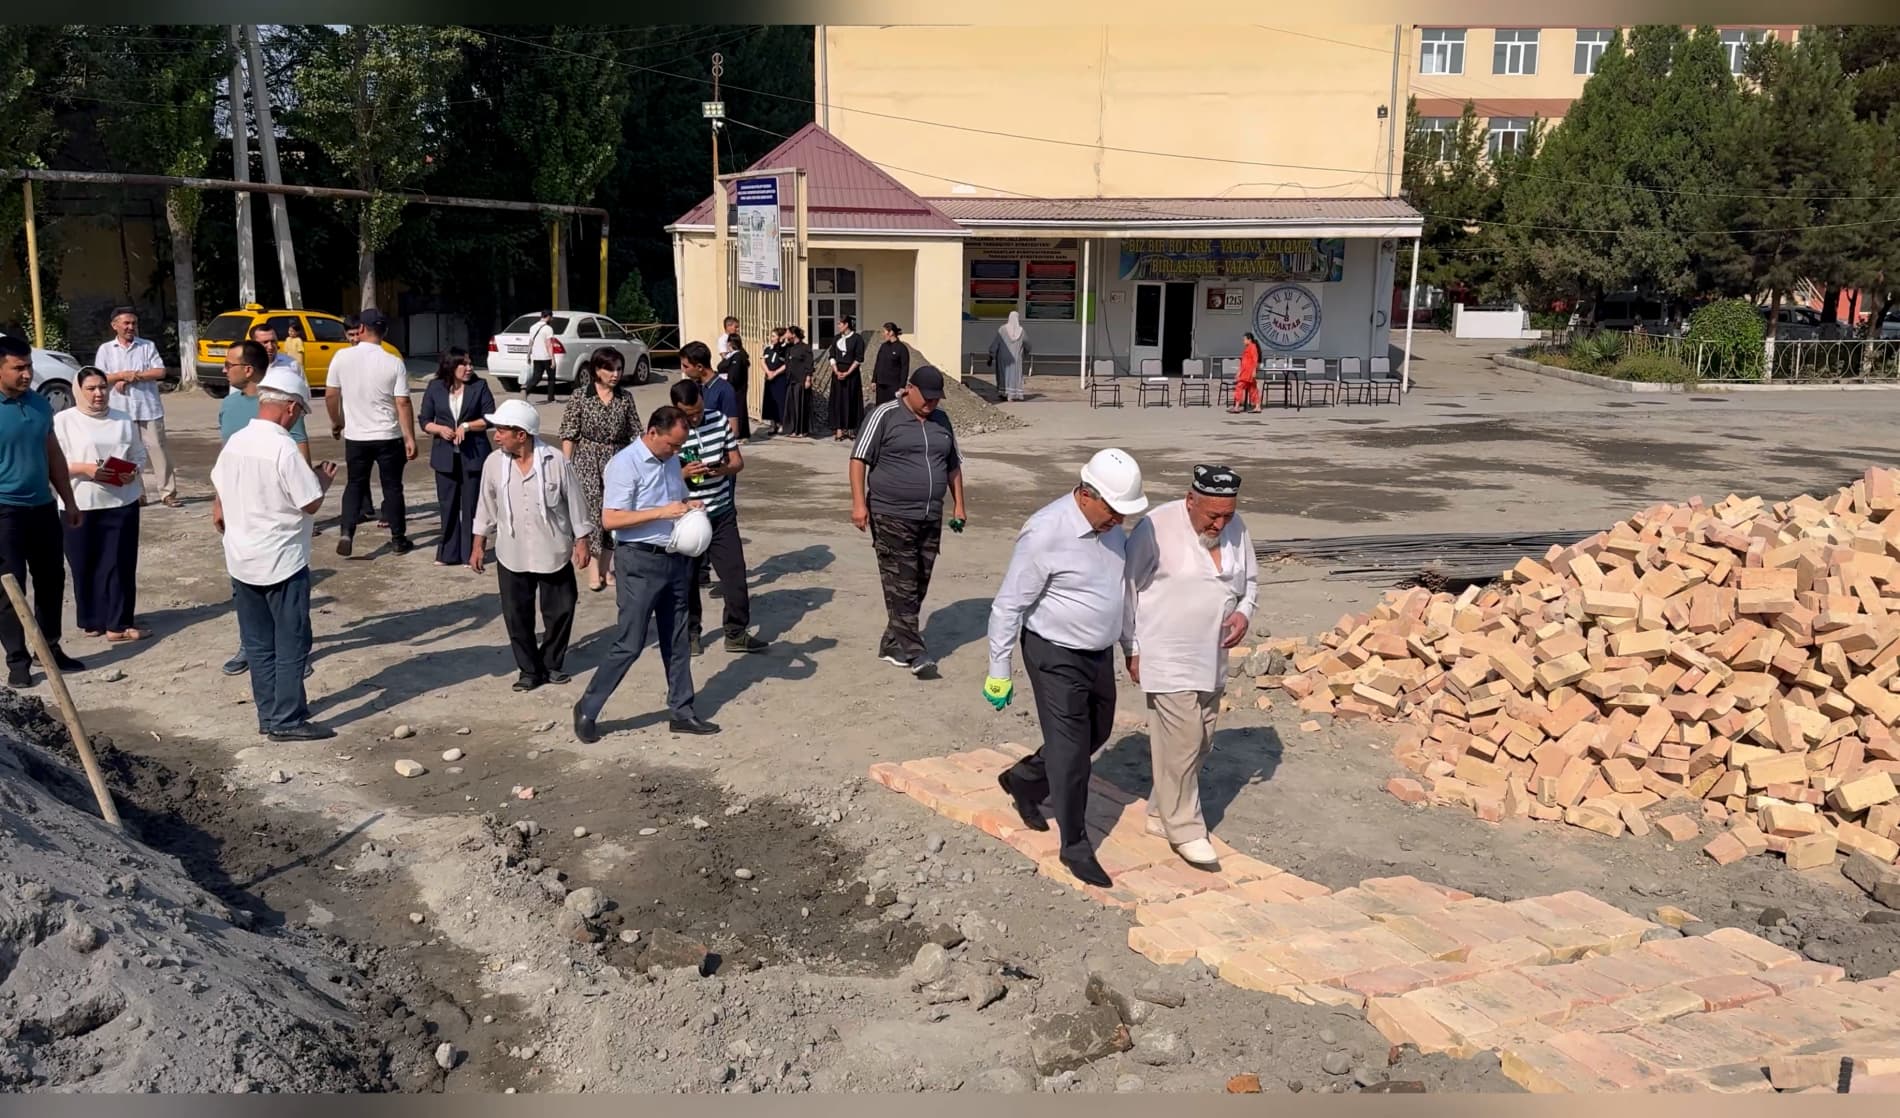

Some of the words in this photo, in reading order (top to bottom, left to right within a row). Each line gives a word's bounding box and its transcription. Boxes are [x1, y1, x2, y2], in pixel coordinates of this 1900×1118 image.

[1128, 239, 1145, 252] BIZ
[1148, 239, 1165, 252] BIR
[1222, 239, 1261, 252] YAGONA
[1152, 259, 1216, 273] BIRLASHSAK
